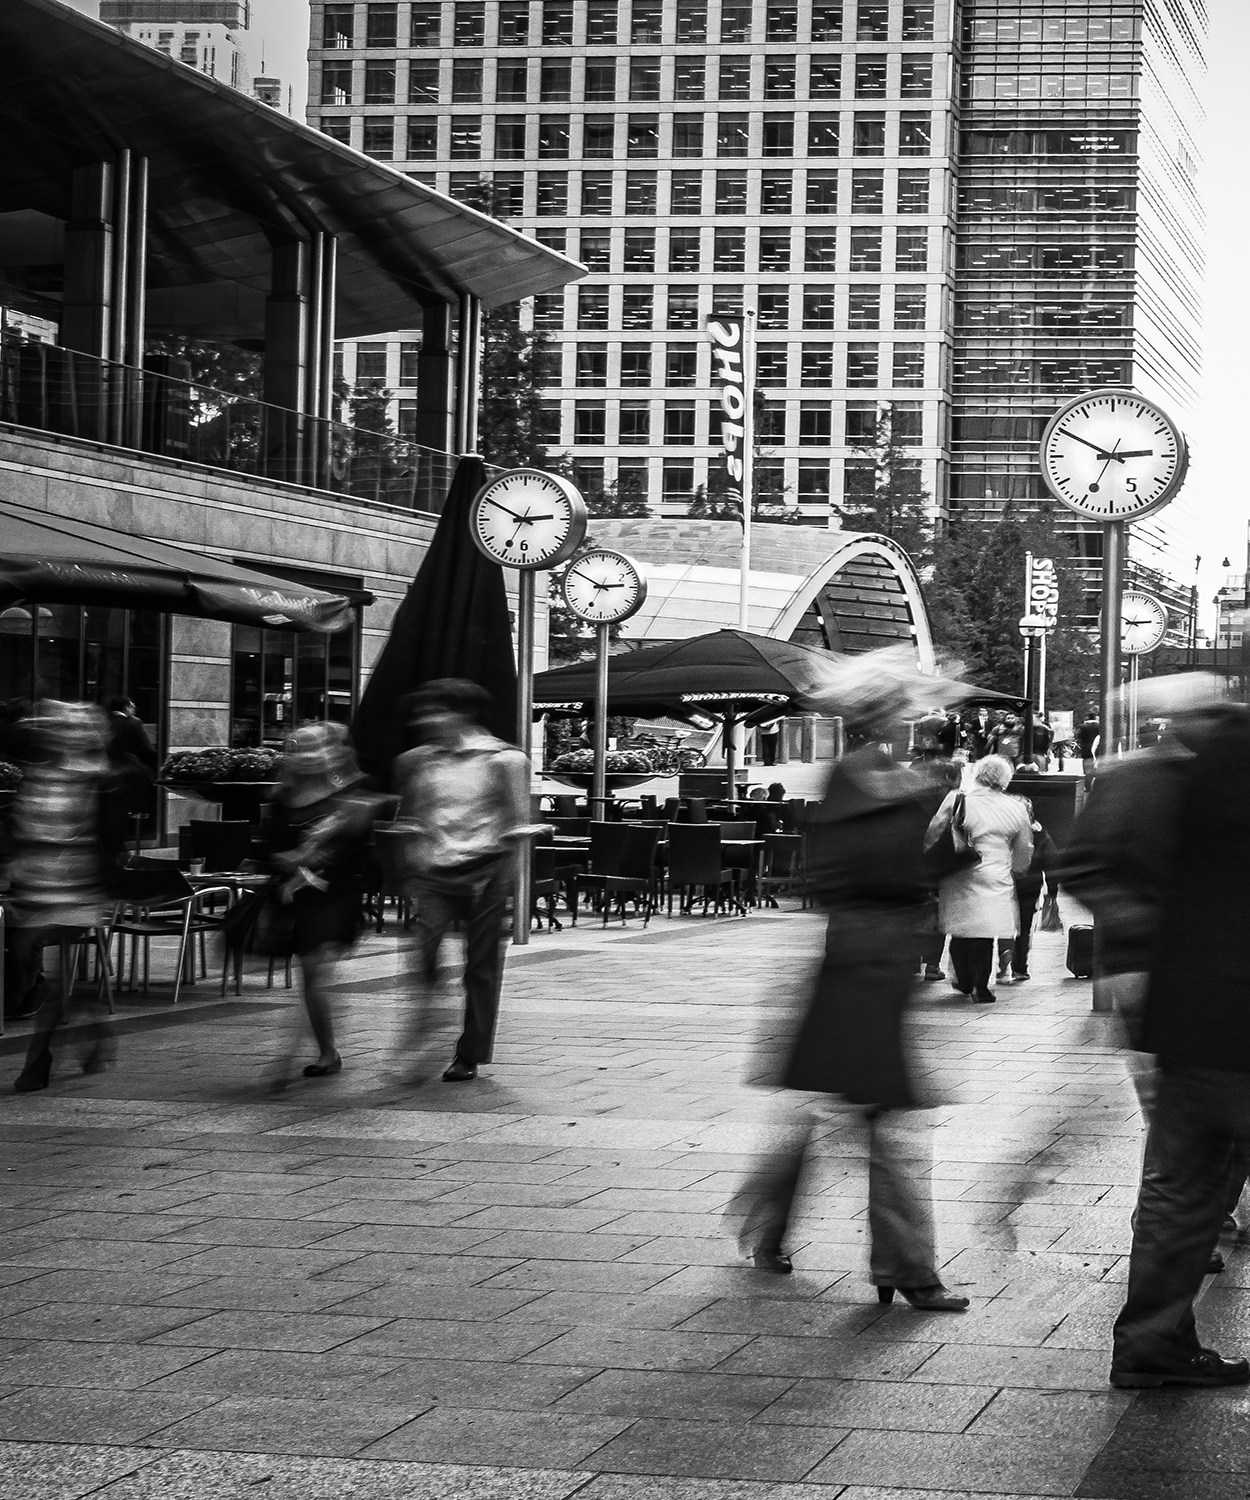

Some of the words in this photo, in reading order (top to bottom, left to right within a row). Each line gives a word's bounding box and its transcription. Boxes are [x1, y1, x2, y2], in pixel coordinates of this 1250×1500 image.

[1126, 477, 1138, 494] 5
[519, 538, 529, 553] 6
[617, 572, 625, 582] 2
